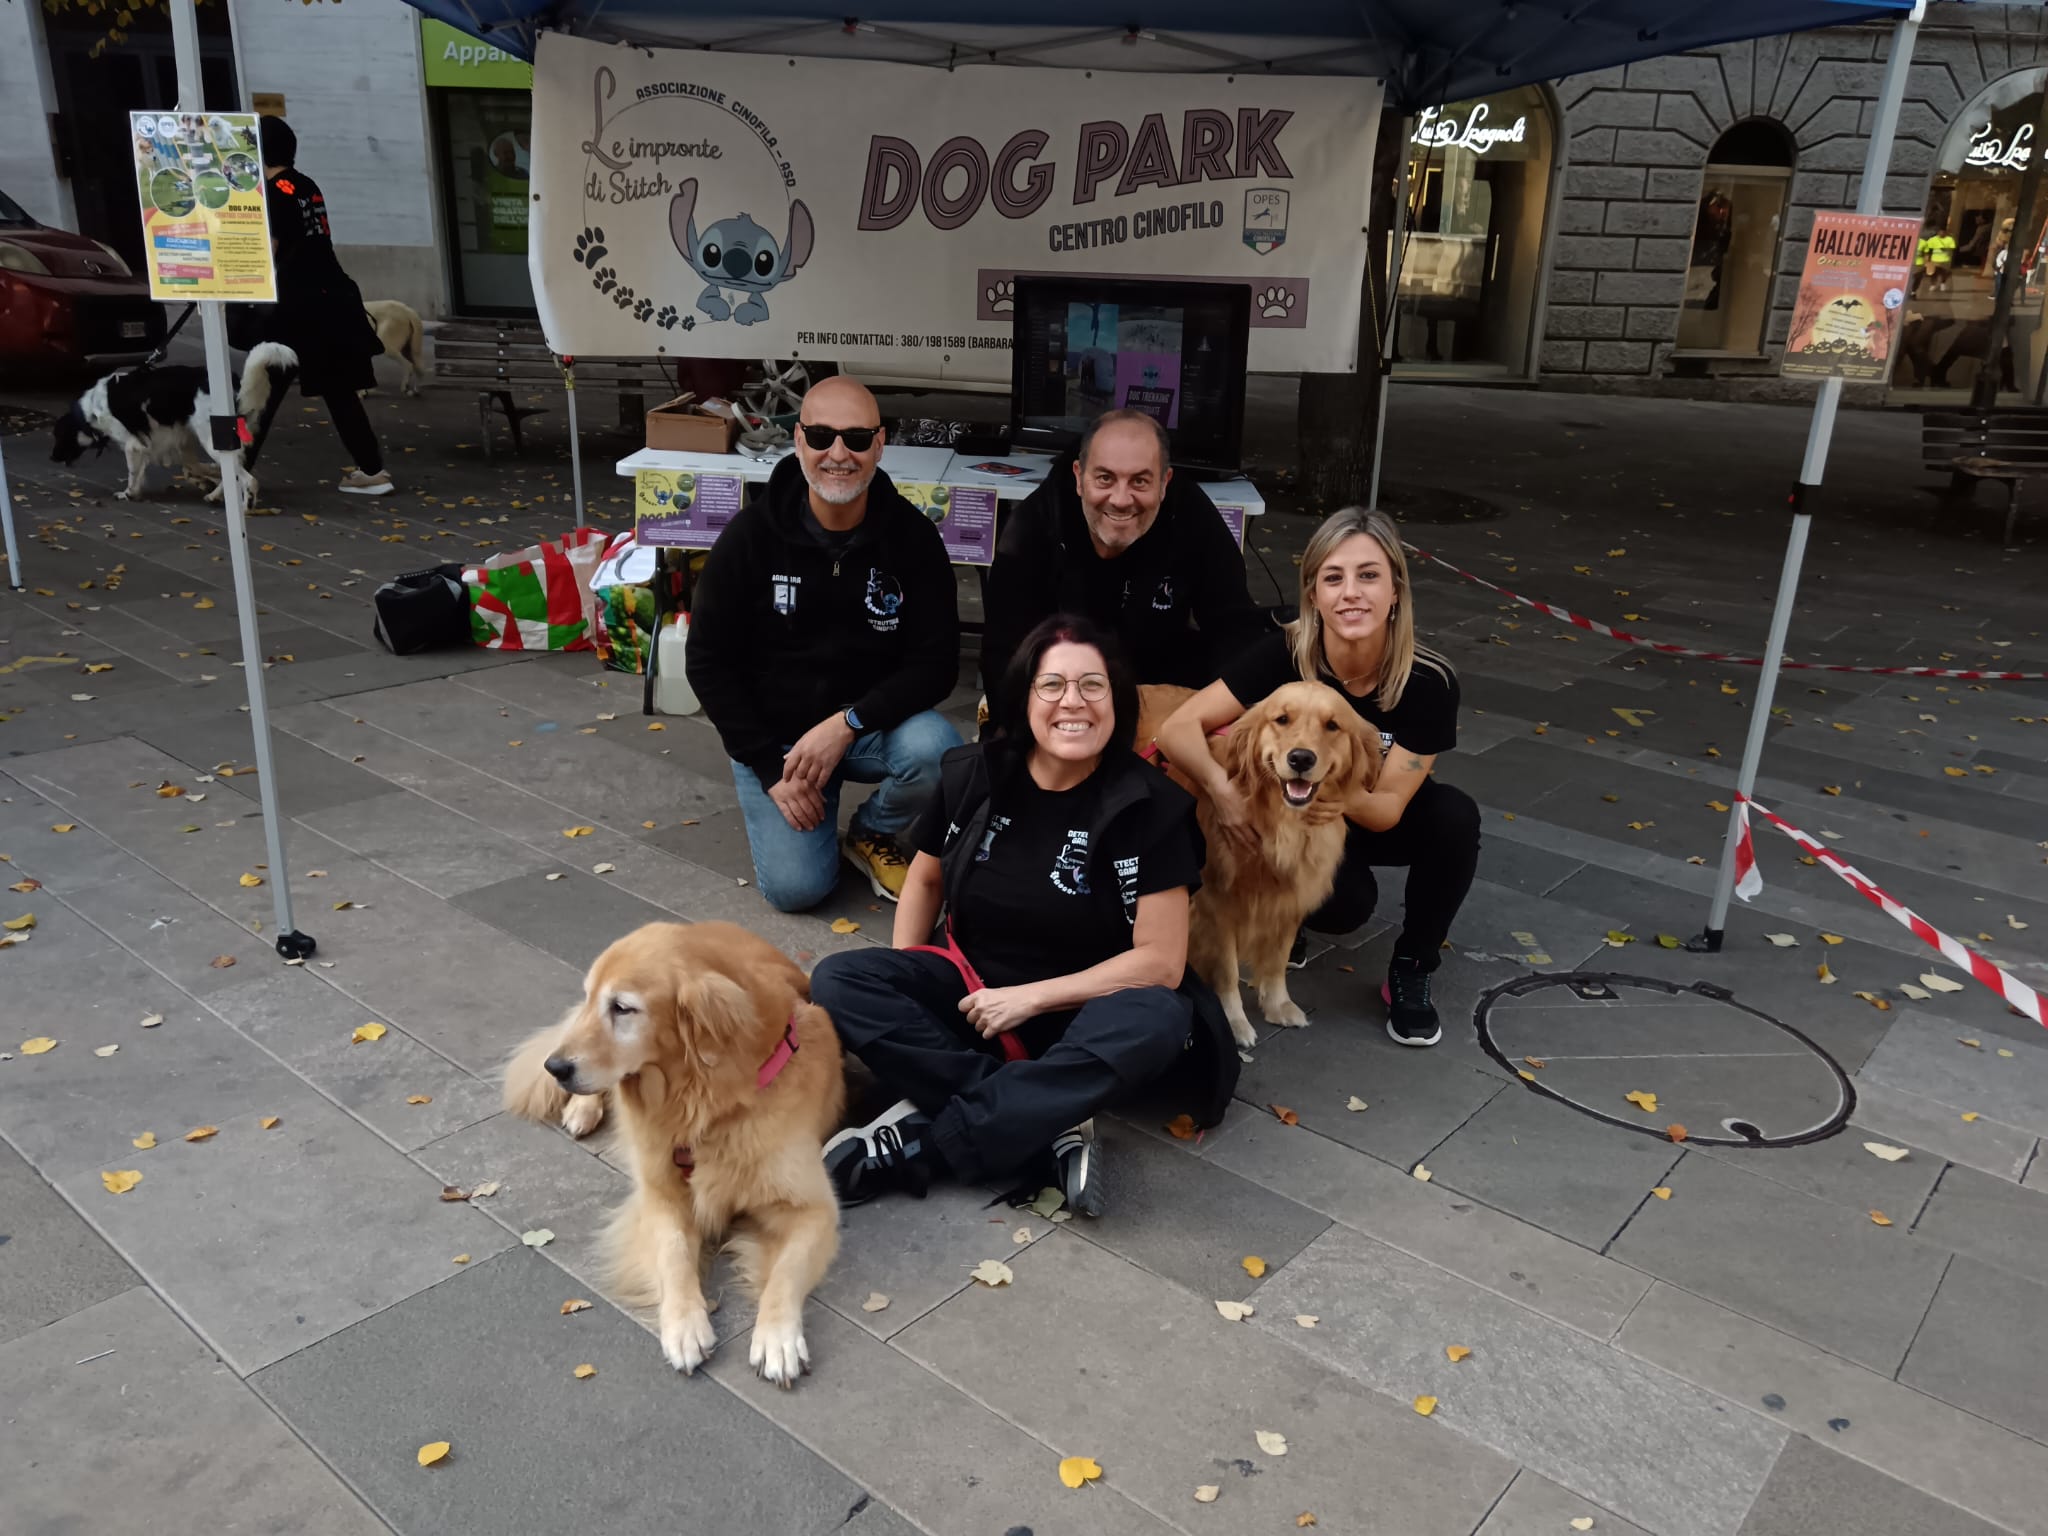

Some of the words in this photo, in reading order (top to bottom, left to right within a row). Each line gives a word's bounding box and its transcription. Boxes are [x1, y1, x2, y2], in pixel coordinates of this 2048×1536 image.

[629, 137, 723, 165] impronte
[636, 82, 727, 105] ASSOCIAZIONE
[731, 101, 778, 148] CINOFILA
[780, 161, 797, 187] ASD
[857, 129, 1055, 232] DOG
[1073, 107, 1295, 206] PARK
[585, 172, 607, 203] di
[609, 170, 673, 205] Stitch
[1253, 193, 1281, 206] OPES
[1049, 215, 1128, 252] CENTRO
[1132, 200, 1224, 240] CINOFILO
[1814, 228, 1912, 260] HALLOWEEN
[797, 331, 815, 345] PER
[817, 332, 838, 345] INFO
[840, 333, 894, 347] CONTATTACI
[901, 335, 966, 349] 380/1981589
